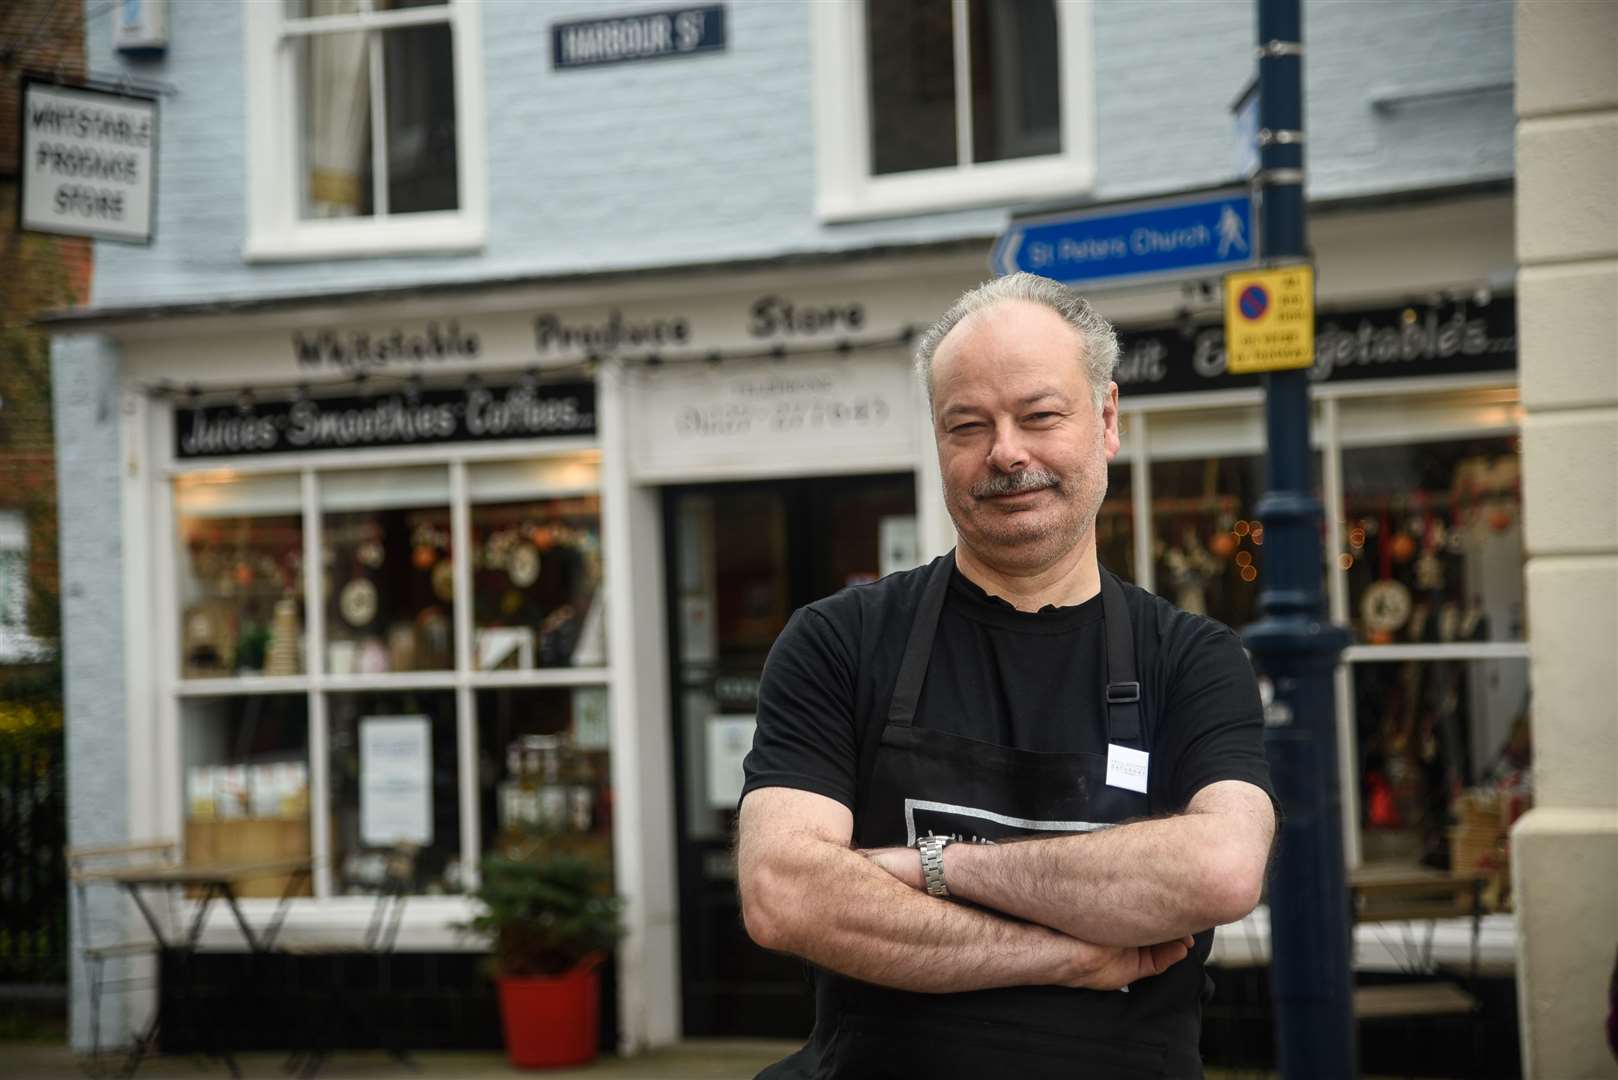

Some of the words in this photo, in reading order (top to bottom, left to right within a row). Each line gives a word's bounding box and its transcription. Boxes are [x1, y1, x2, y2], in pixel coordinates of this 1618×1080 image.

[562, 15, 671, 61] HARBOUR
[32, 102, 150, 147] WHITSTABLE
[36, 141, 140, 184] PRODUCE
[53, 183, 127, 221] STORE
[1029, 241, 1054, 268] St
[1058, 236, 1129, 265] Peters
[1131, 223, 1210, 255] Church
[293, 320, 480, 368] Whitstable
[533, 309, 690, 353] Produce
[749, 296, 865, 338] Store
[286, 397, 456, 446] Smoothies
